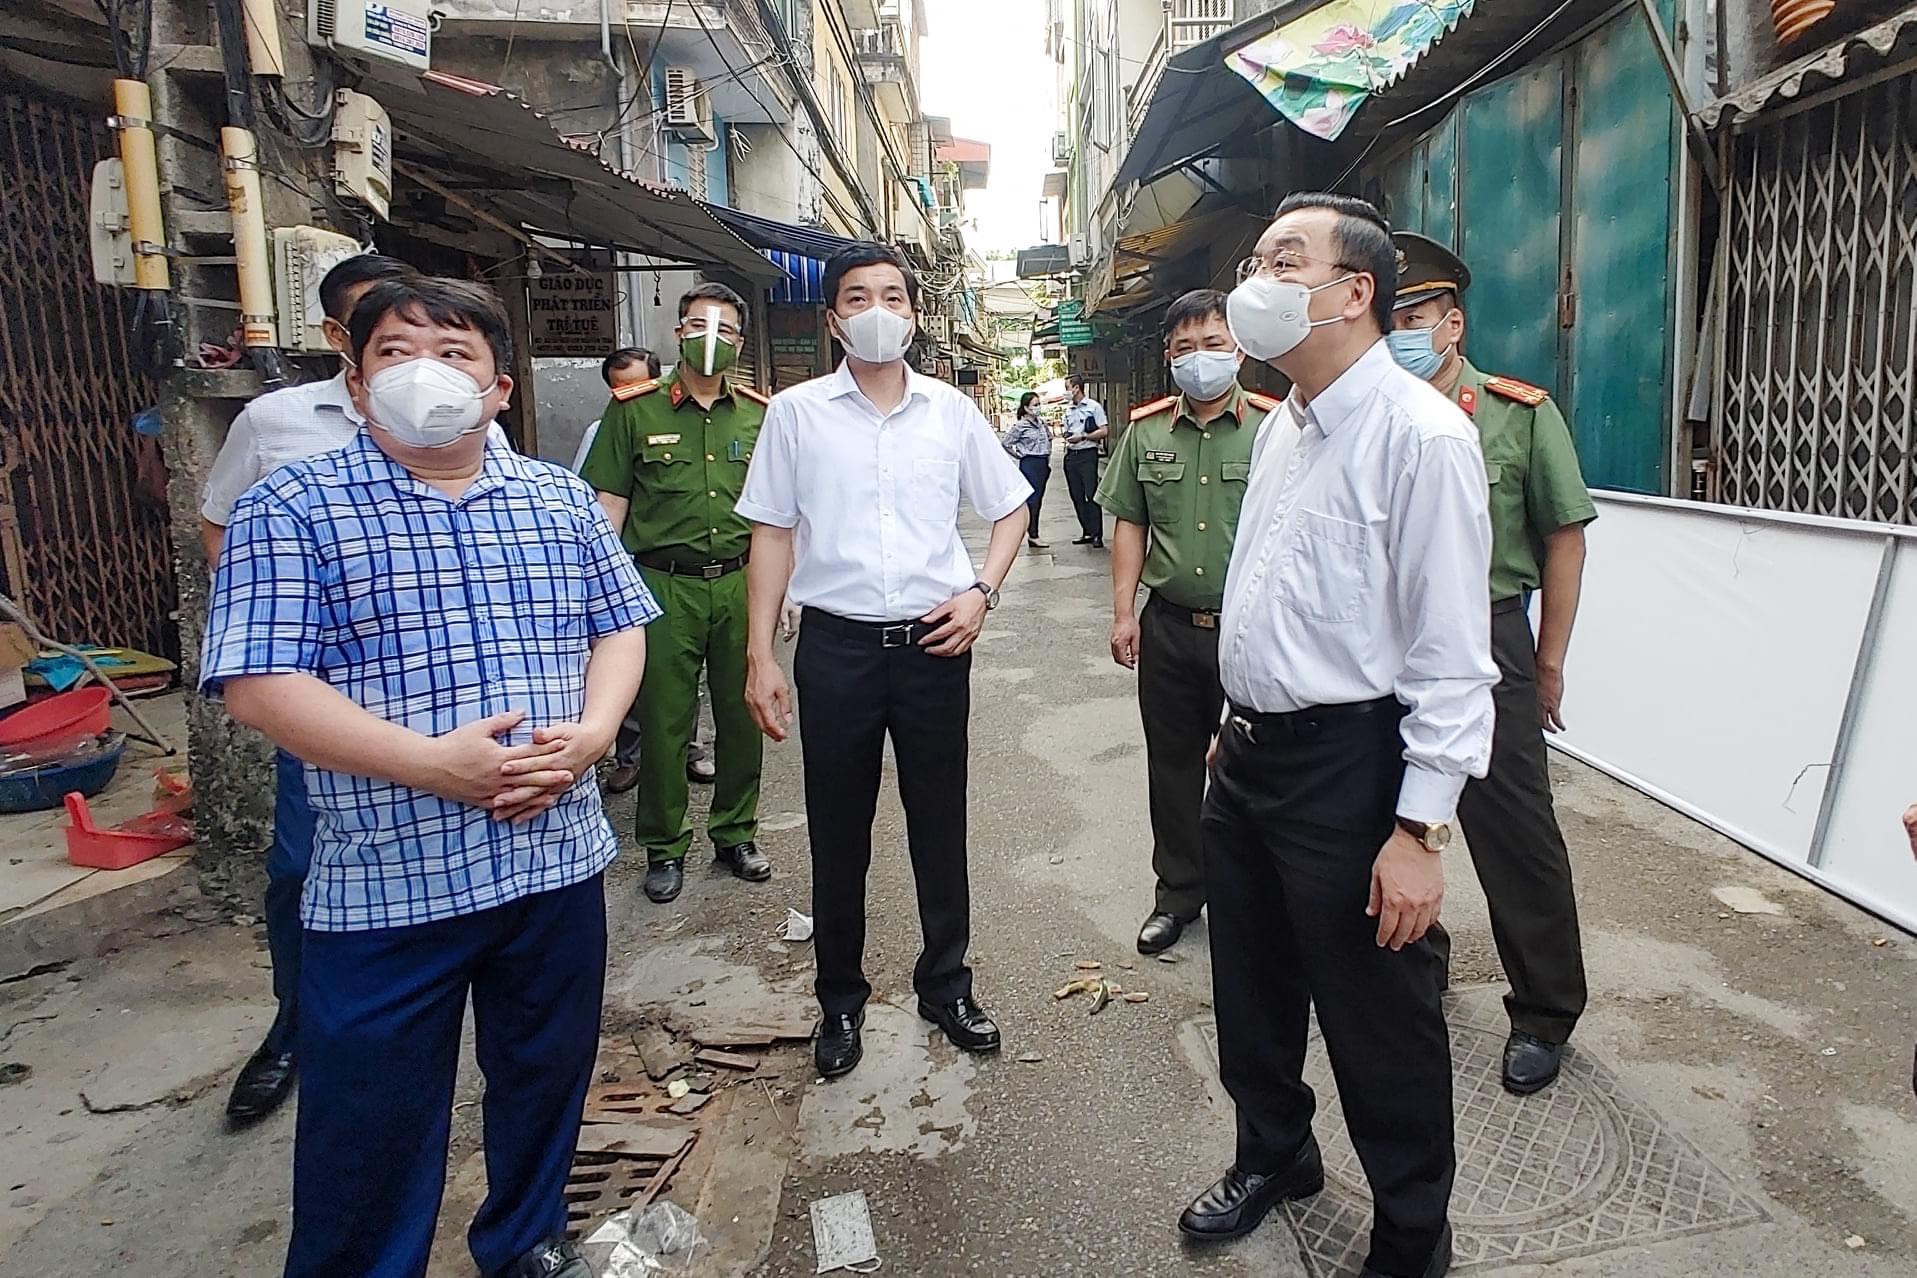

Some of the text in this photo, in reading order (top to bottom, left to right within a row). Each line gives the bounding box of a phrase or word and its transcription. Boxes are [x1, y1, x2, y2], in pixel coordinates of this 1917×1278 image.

[539, 275, 604, 294] GIÁO DỤC
[533, 292, 611, 311] PHÁT TRIỂN
